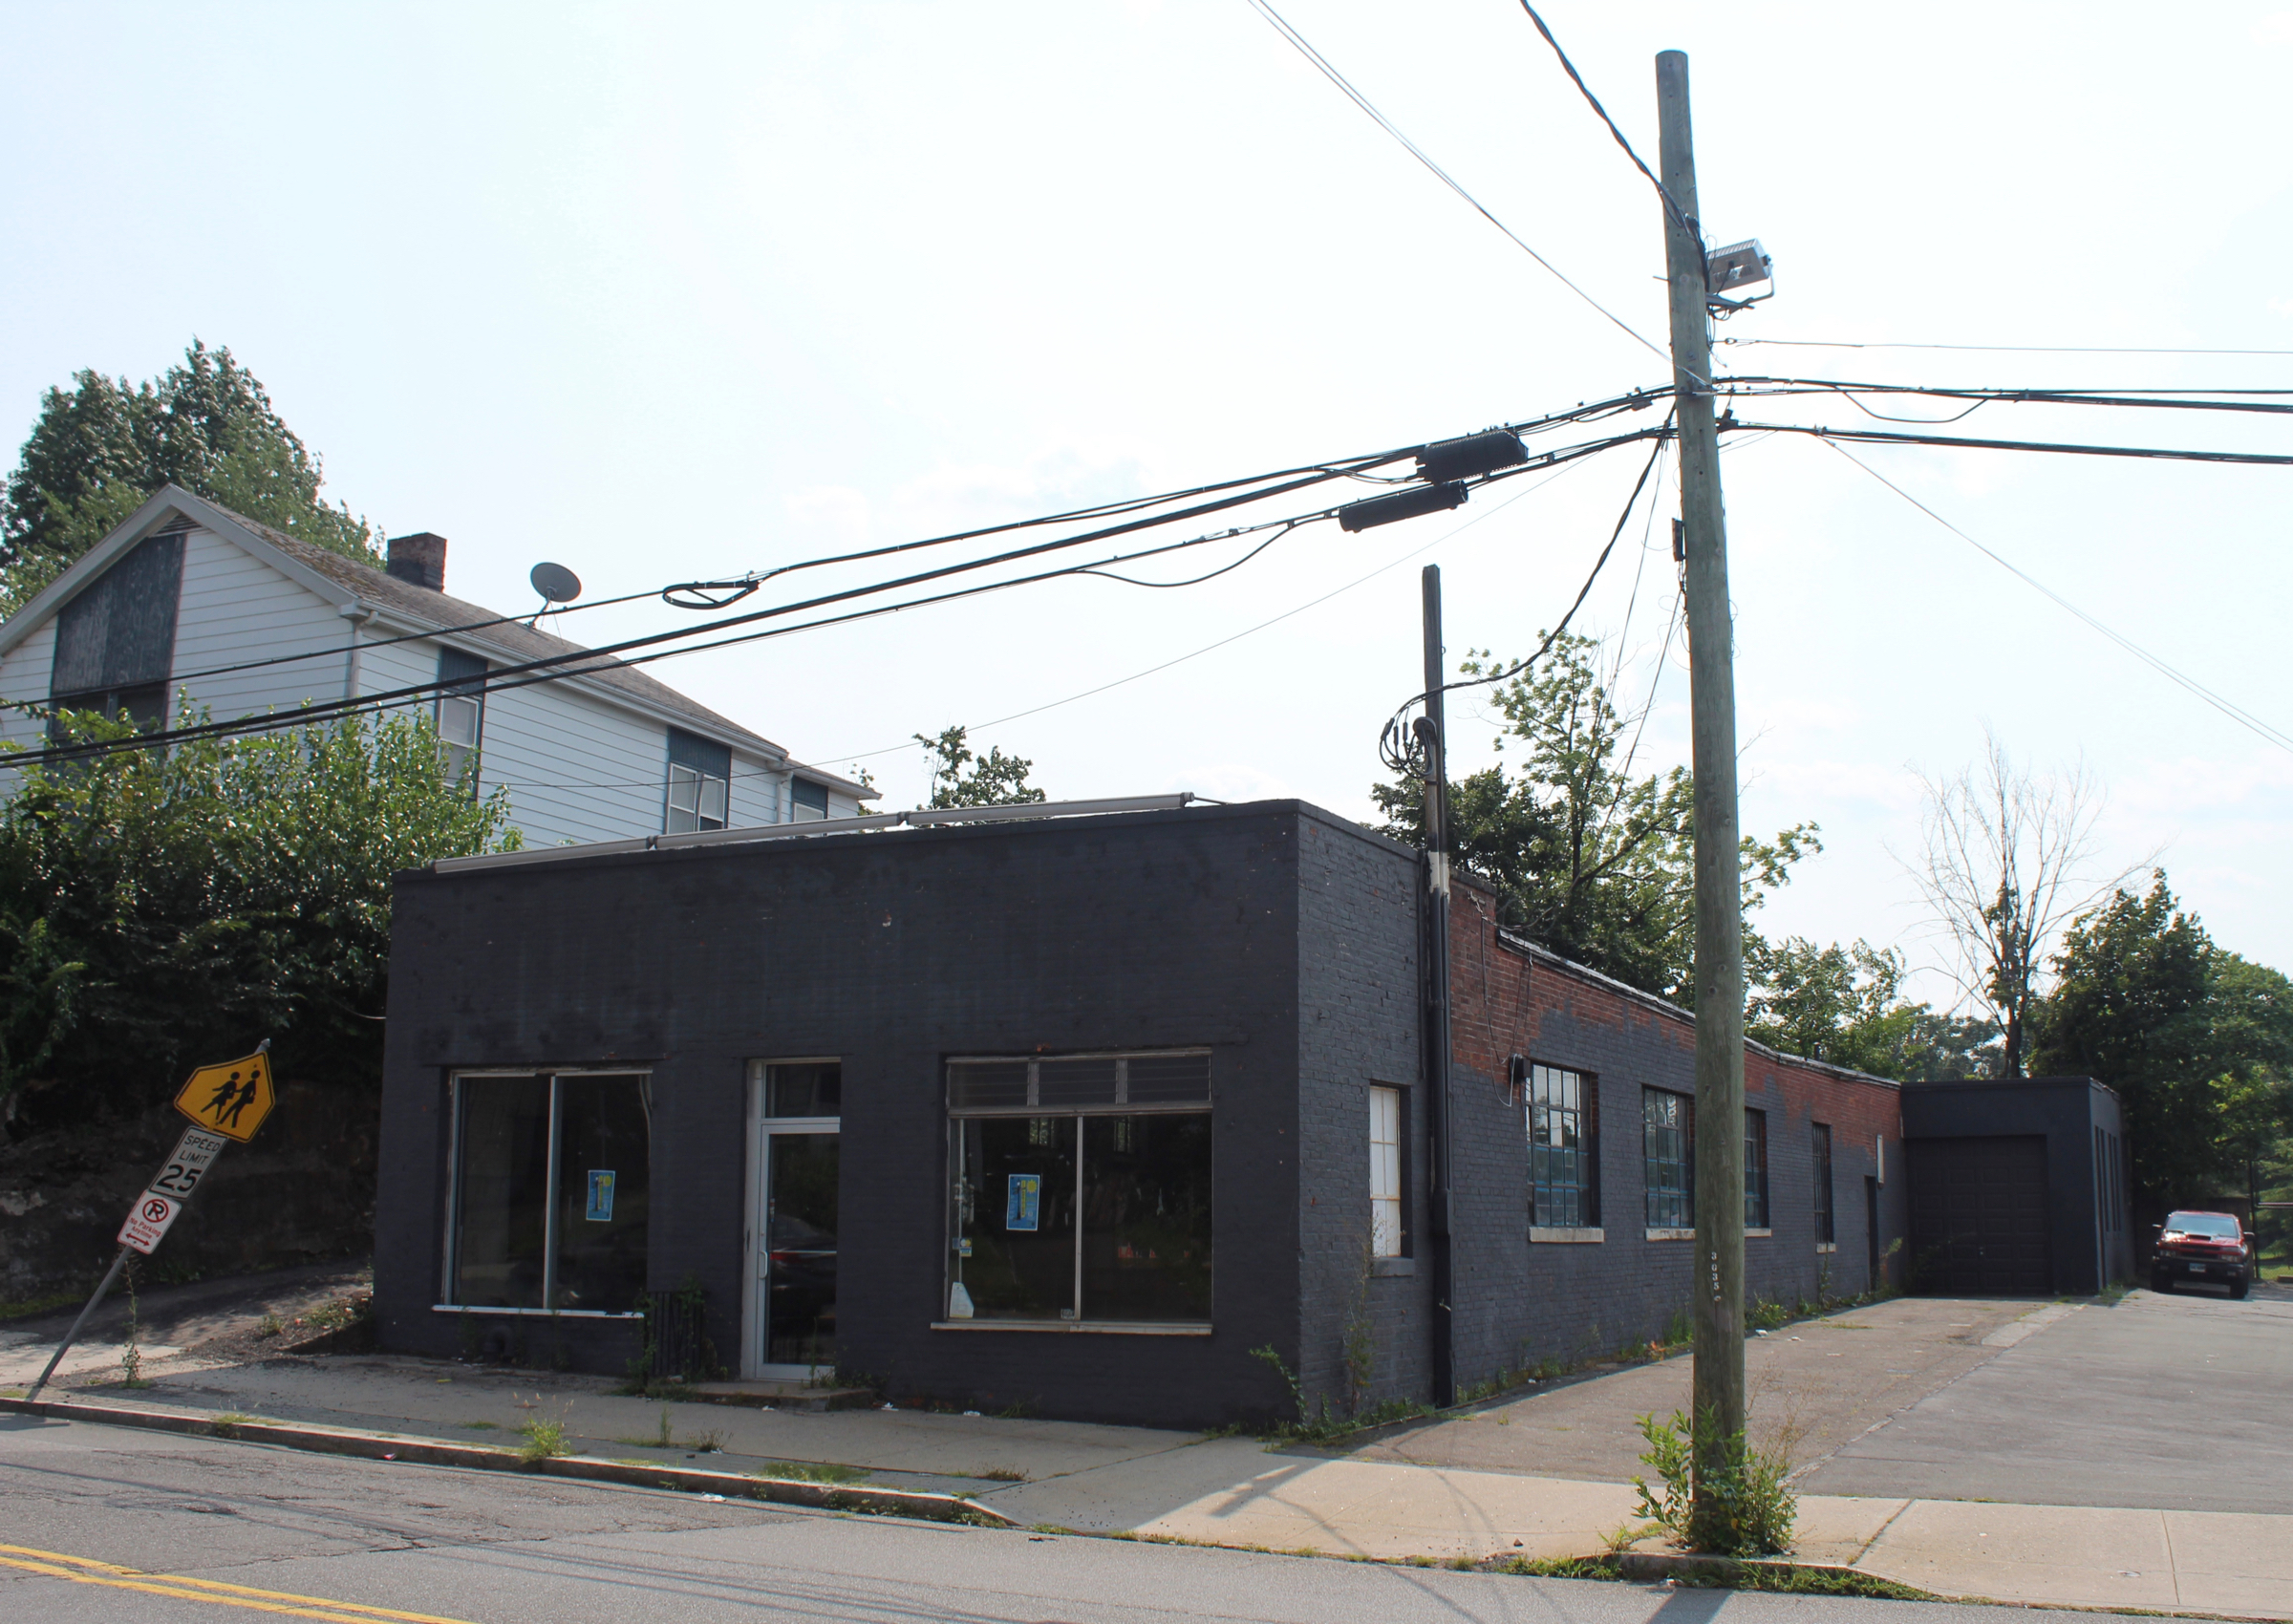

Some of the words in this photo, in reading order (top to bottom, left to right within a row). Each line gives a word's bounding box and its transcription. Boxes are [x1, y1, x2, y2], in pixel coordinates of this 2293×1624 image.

[184, 1135, 221, 1152] SPEED
[179, 1149, 209, 1165] LIMIT
[156, 1164, 203, 1192] 25
[130, 1217, 139, 1226] No
[139, 1221, 162, 1238] Parking
[132, 1226, 153, 1240] Anytime
